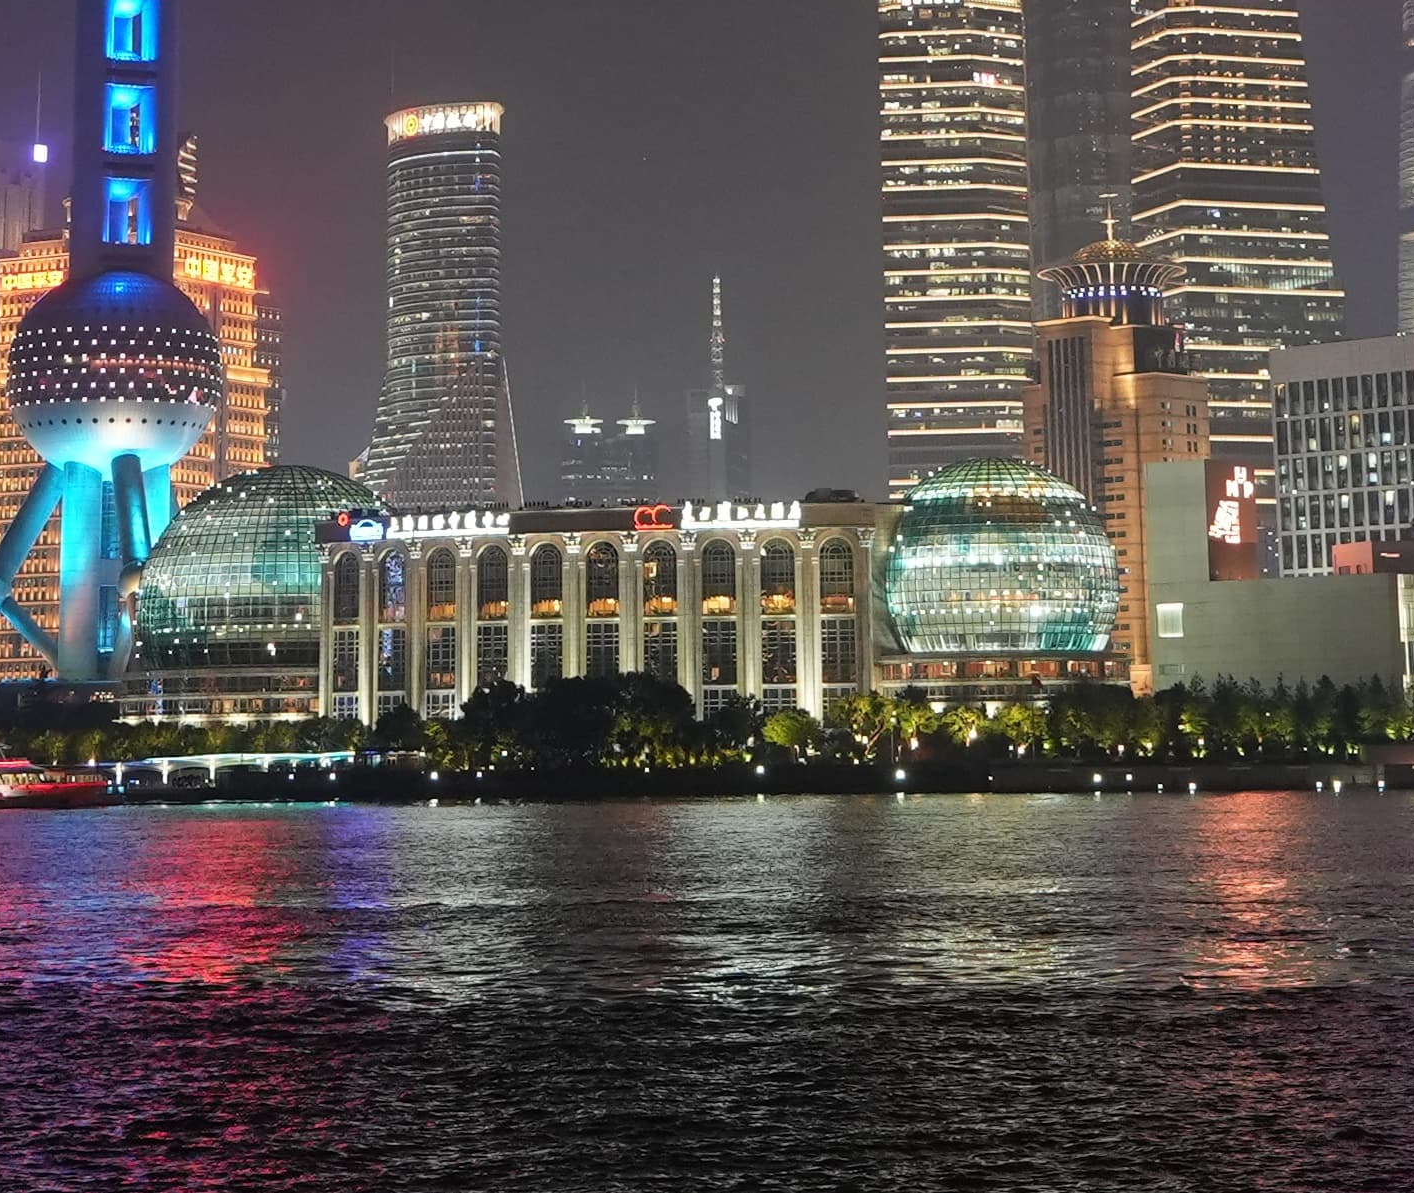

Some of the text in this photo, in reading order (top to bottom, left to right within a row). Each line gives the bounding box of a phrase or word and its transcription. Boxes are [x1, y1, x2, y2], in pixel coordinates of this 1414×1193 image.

[1, 270, 64, 290] 中国平安
[185, 256, 254, 289] 中国平安
